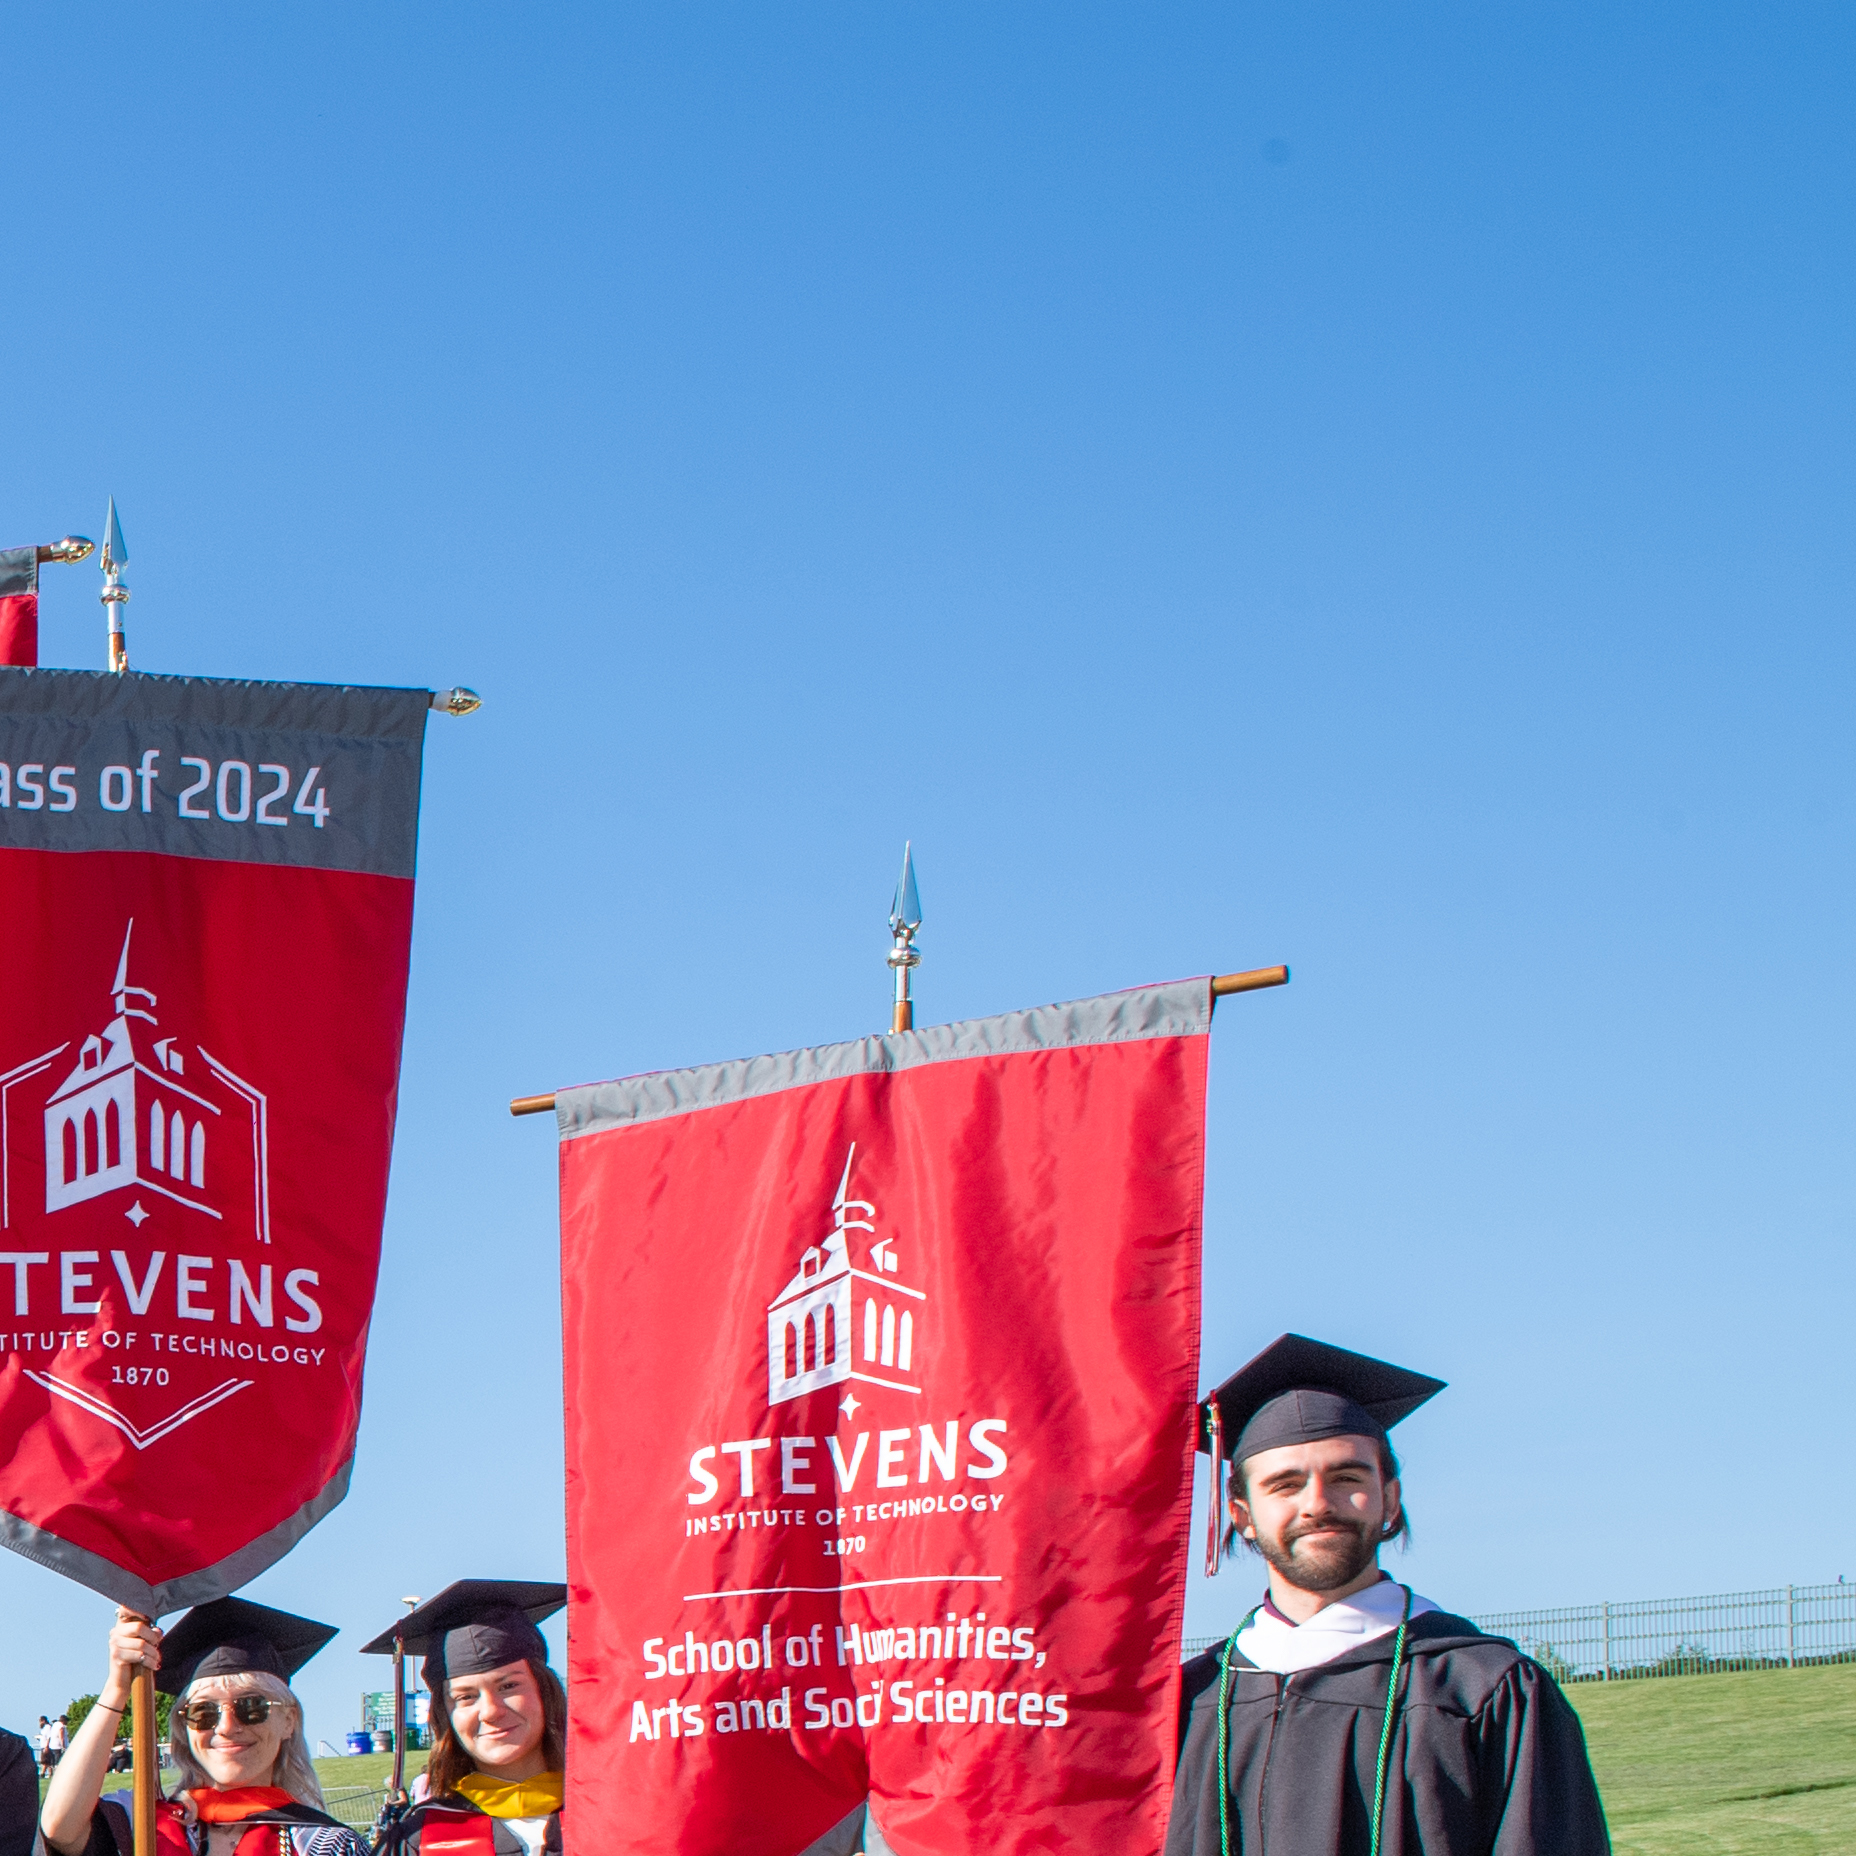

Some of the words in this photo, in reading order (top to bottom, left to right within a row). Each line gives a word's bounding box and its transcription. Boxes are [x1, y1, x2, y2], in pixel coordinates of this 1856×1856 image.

[99, 749, 160, 813] of
[178, 756, 330, 828] 2024
[102, 1330, 137, 1350] OF
[150, 1334, 326, 1366] TECHNOLOGY
[112, 1365, 170, 1386] 1870
[687, 1419, 1008, 1505] STEVENS
[685, 1509, 806, 1538] INSTITUTE
[816, 1507, 847, 1526] OF
[852, 1493, 1004, 1524] TECHNOLOGY
[823, 1535, 867, 1556] 1870
[642, 1624, 772, 1680] School
[785, 1623, 824, 1667] of
[834, 1611, 1046, 1669] Humanities,
[628, 1698, 705, 1744] Arts
[714, 1686, 792, 1733] and
[889, 1677, 1068, 1728] Sciences
